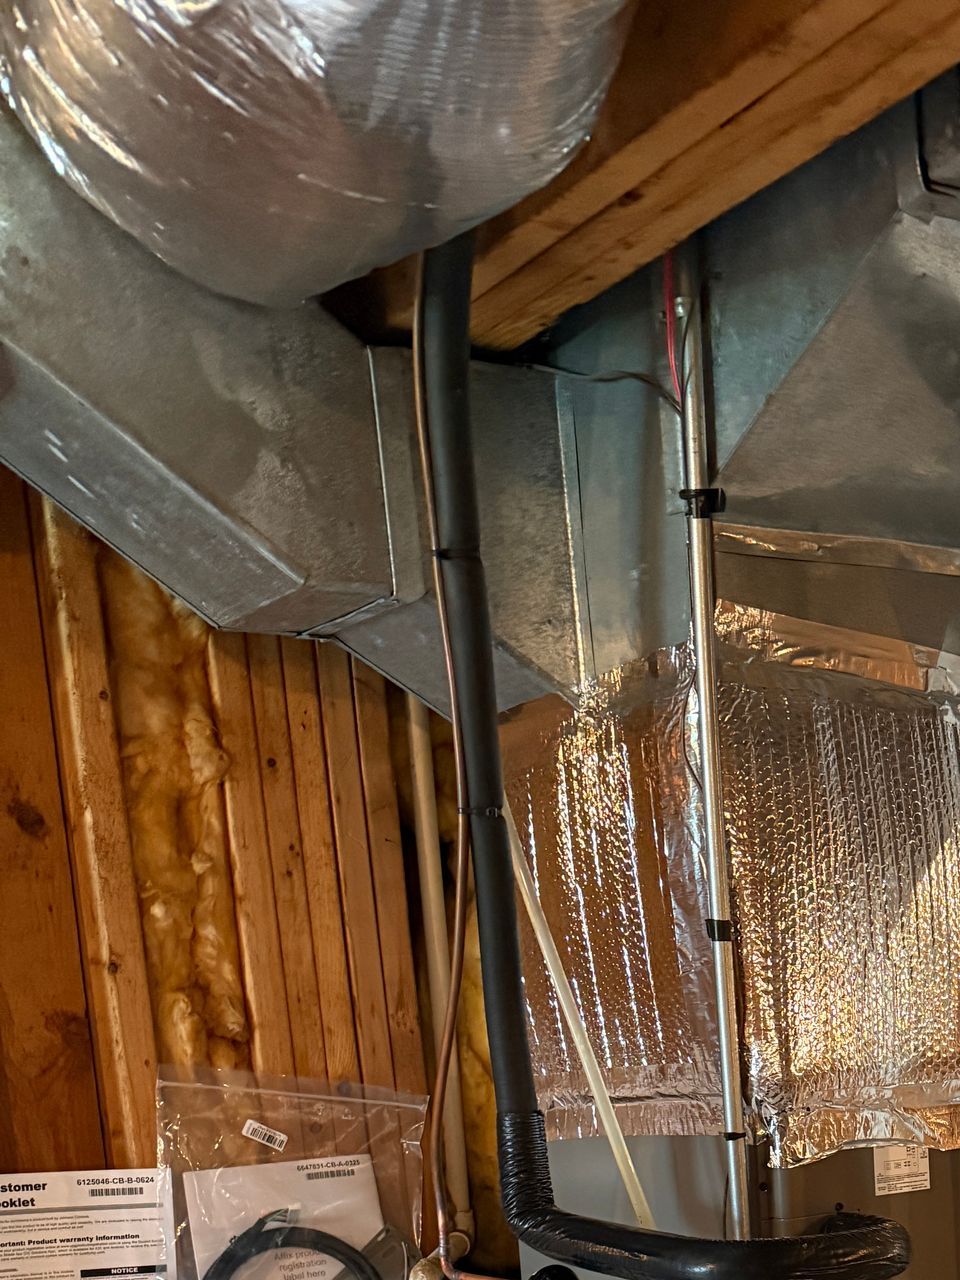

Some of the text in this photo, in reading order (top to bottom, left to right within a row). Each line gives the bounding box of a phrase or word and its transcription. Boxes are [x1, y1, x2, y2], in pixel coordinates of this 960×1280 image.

[0, 1182, 48, 1192] stomer
[60, 1235, 94, 1244] warranty
[96, 1233, 140, 1241] information
[295, 1250, 320, 1260] produ
[279, 1258, 327, 1272] registration
[111, 1267, 139, 1275] NOTICE
[307, 1269, 326, 1278] here
